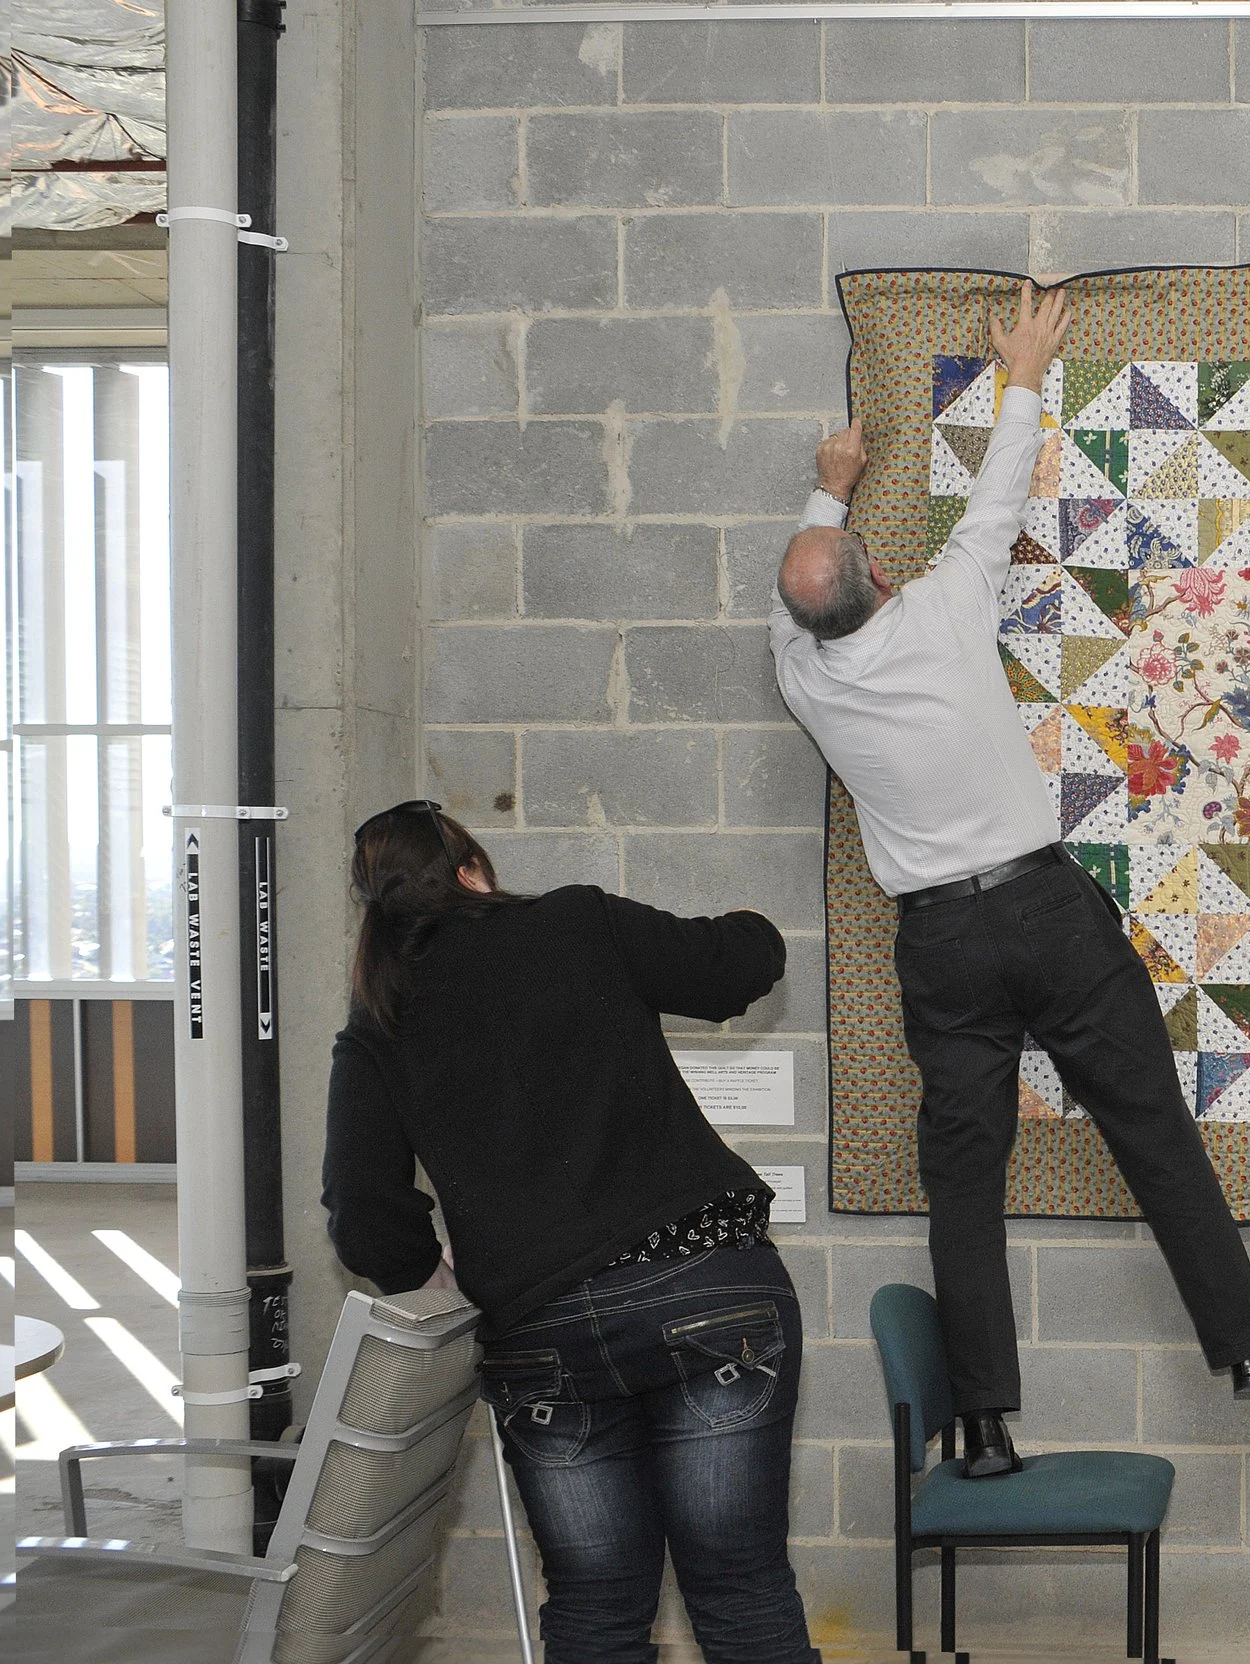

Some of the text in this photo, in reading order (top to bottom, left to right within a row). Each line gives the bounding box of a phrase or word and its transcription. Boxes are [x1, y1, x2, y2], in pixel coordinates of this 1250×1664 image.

[187, 872, 202, 1024] LAB WASTE VENT
[258, 881, 270, 972] LAB WASTE
